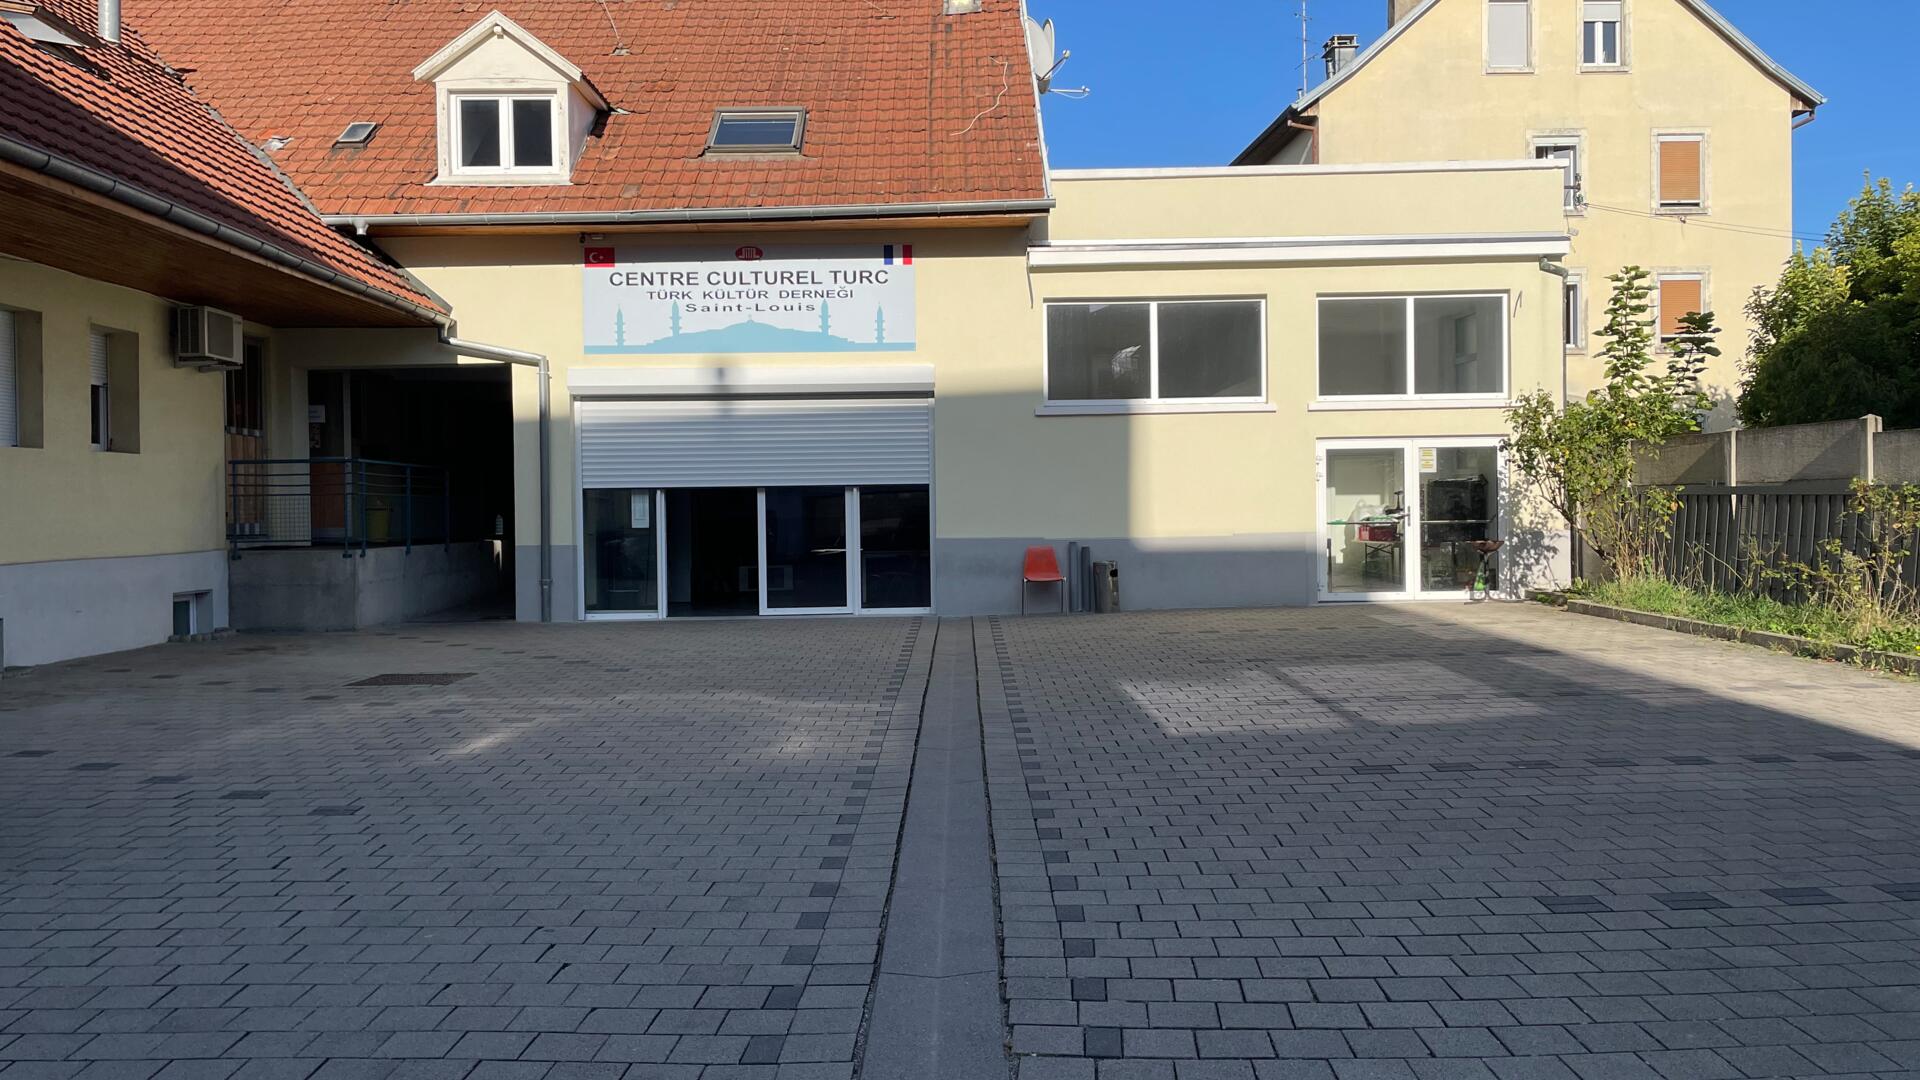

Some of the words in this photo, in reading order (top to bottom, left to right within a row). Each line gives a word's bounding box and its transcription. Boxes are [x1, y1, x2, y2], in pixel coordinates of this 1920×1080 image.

[609, 270, 699, 286] CENTRE
[706, 270, 822, 286] CULTUREL
[829, 269, 889, 285] TURC
[647, 289, 692, 300] TÜRK
[703, 289, 769, 300] KÜLTÜR
[685, 302, 816, 312] Saint-Louis
